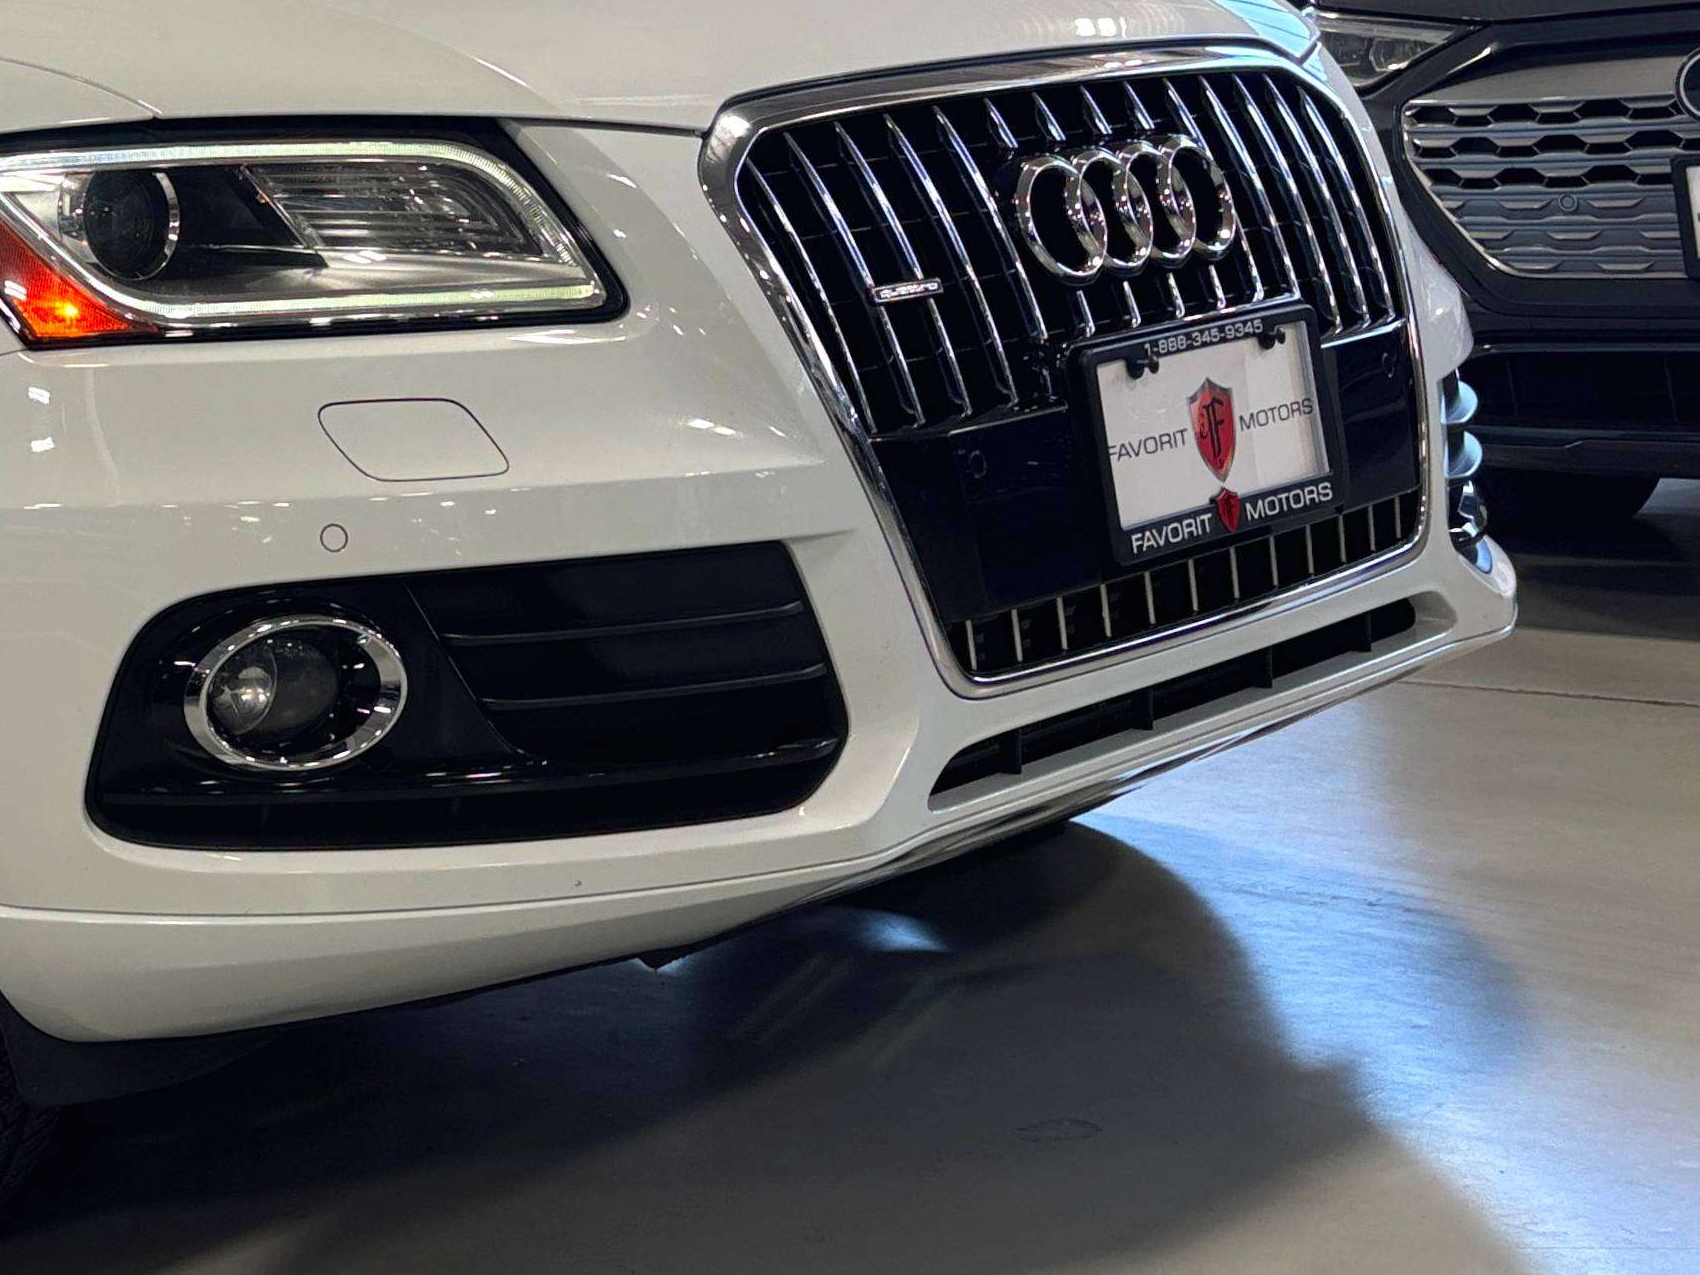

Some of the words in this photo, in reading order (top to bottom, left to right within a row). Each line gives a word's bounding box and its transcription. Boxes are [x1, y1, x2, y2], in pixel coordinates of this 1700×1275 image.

[1144, 319, 1263, 356] 1-888-345-9345
[1239, 398, 1314, 432] MOTORS
[1131, 513, 1212, 555] FAVORIT
[1245, 482, 1333, 521] MOTORS
